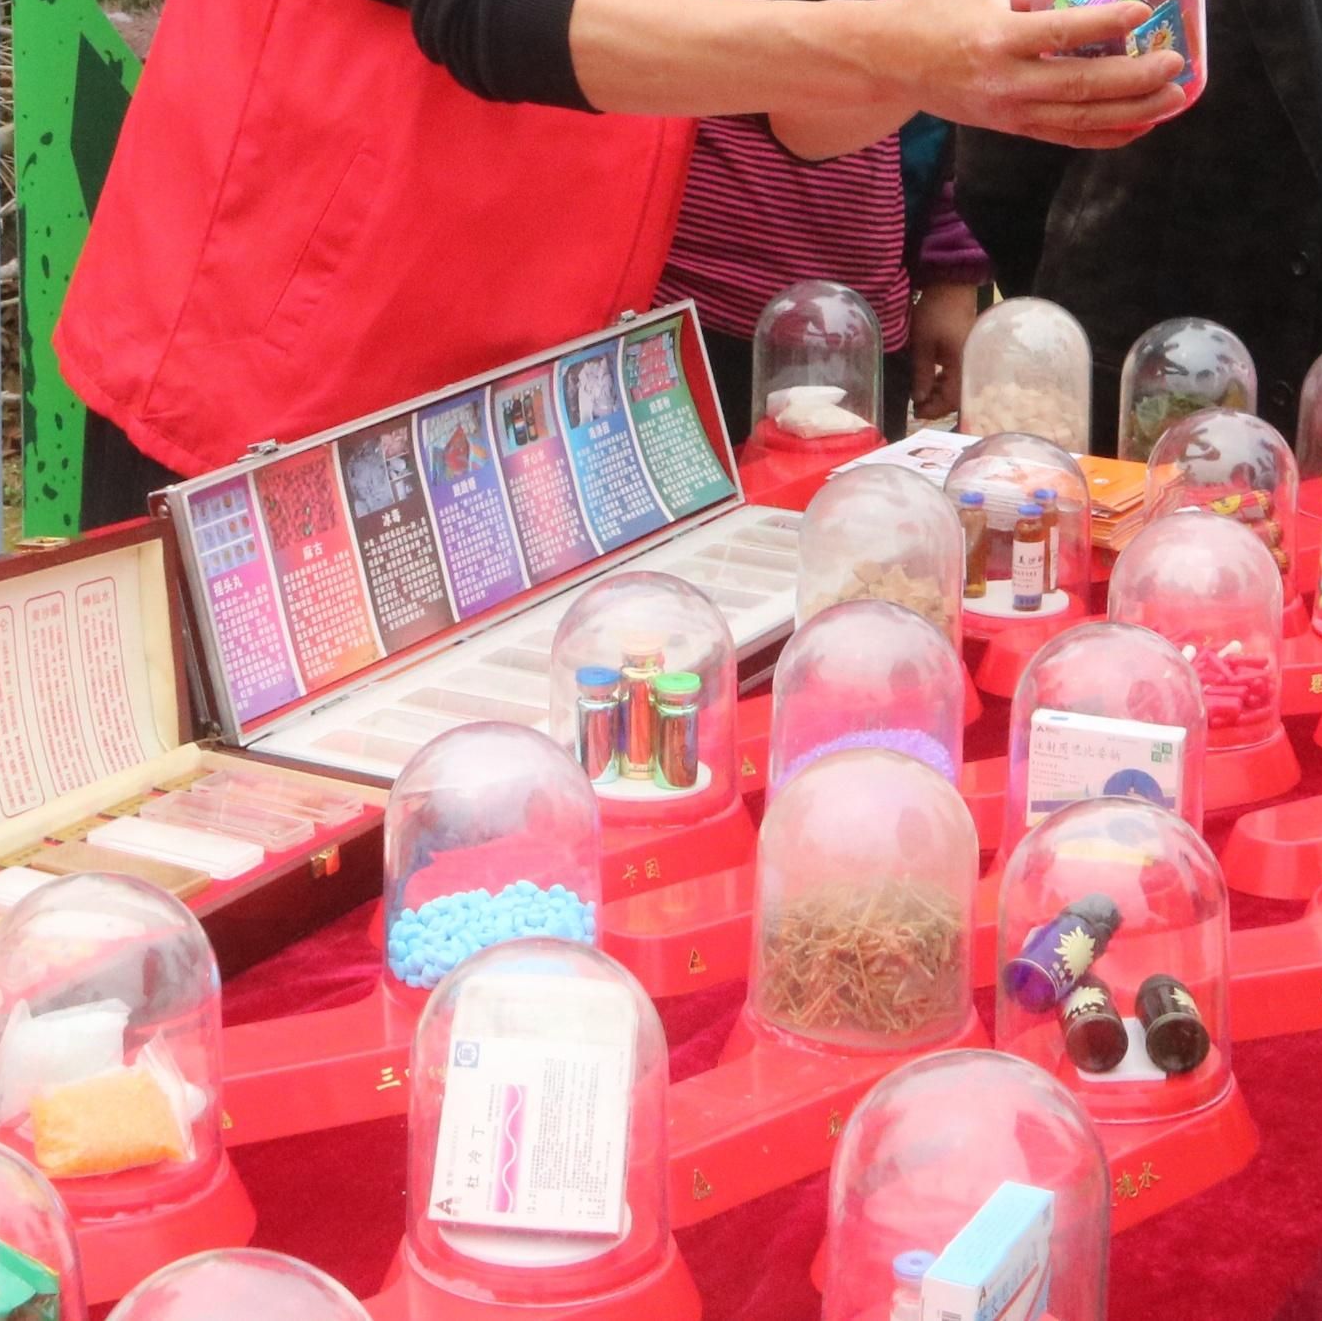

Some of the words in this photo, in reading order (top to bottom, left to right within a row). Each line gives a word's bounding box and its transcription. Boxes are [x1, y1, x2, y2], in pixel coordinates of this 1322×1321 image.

[381, 508, 402, 527] 冰毒
[302, 541, 324, 561] 麻古
[212, 573, 244, 599] 摇头丸
